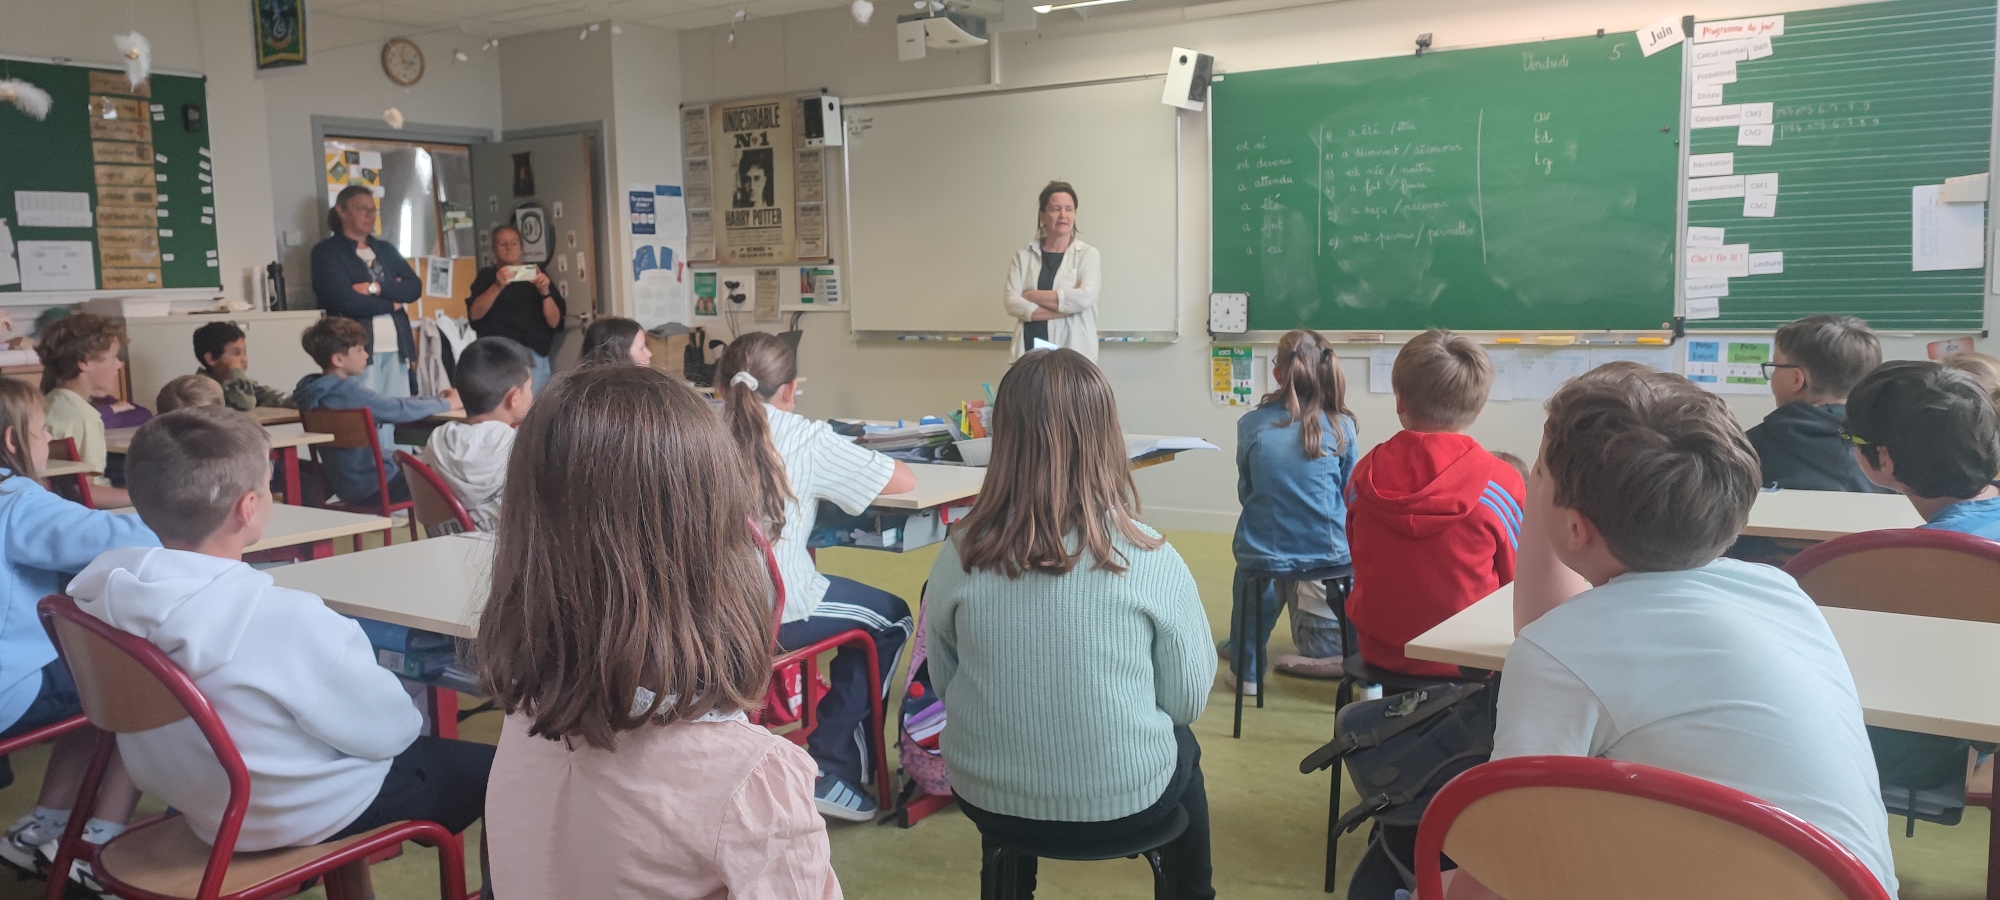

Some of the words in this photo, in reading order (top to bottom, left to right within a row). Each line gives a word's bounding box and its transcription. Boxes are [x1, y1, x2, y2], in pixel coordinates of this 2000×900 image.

[1702, 25, 1743, 38] Programme
[1747, 22, 1756, 31] du
[1758, 21, 1775, 35] jour
[1649, 25, 1673, 46] Juin
[1608, 43, 1626, 60] 5
[1753, 42, 1769, 52] Défi
[1696, 50, 1718, 60] Calcul
[1719, 46, 1746, 56] mental
[1697, 69, 1736, 80] Problèmes
[1695, 112, 1740, 124] Conjugaison
[1744, 110, 1763, 118] CM1
[1362, 122, 1381, 136] été
[1744, 128, 1762, 137] CM2
[1256, 158, 1294, 168] devenu
[1692, 159, 1732, 169] Récréation
[1254, 174, 1294, 187] attendu
[1690, 183, 1744, 193] Mathématiques
[1750, 182, 1768, 190] CM1
[1750, 201, 1768, 210] CM2
[725, 209, 750, 227] HARRY
[752, 208, 782, 227] POTTER
[1753, 259, 1782, 269] Lecture
[1688, 281, 1727, 292] Récréation
